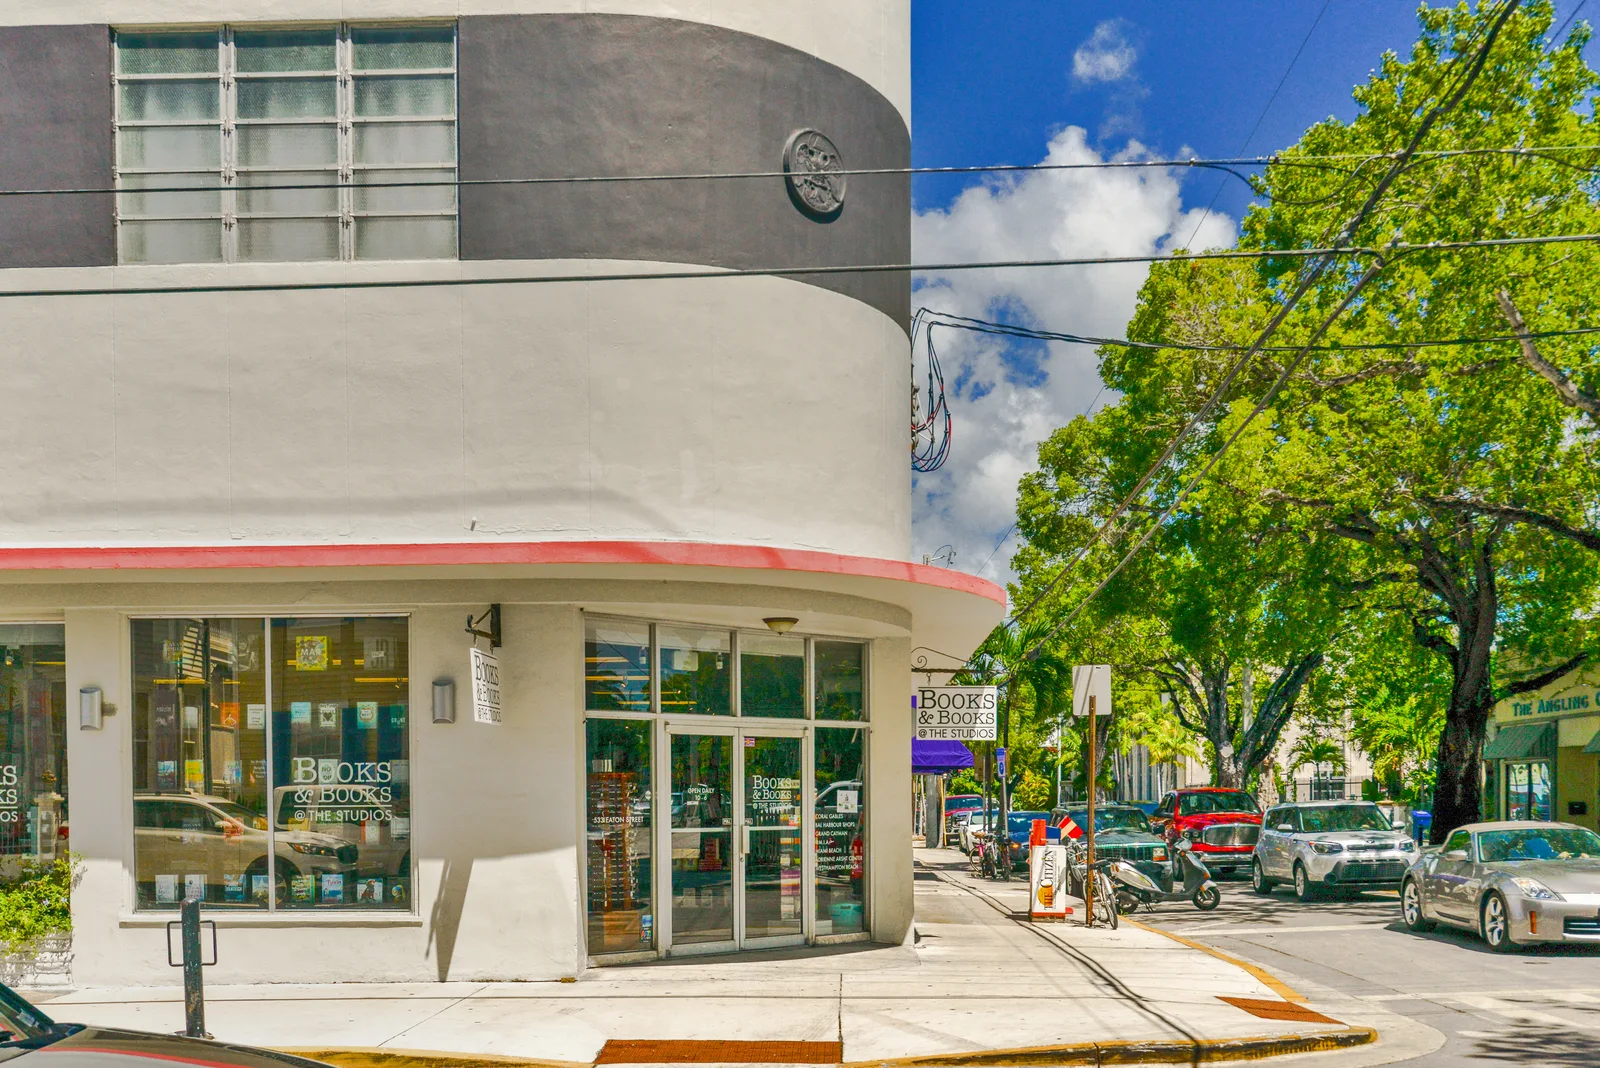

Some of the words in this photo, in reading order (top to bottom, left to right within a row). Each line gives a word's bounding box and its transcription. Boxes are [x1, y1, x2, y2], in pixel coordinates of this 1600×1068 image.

[474, 655, 499, 686] BOOKS
[483, 684, 500, 705] BOOKS
[918, 689, 995, 710] BOOKS
[1512, 702, 1533, 717] THE
[1537, 695, 1590, 714] ANGLING
[918, 710, 934, 725] &
[937, 710, 995, 725] BOOKS
[918, 728, 928, 739] @
[929, 728, 947, 738] THE
[951, 728, 994, 739] STUDIOS
[293, 757, 392, 783] BOOKS
[752, 774, 792, 789] BOOKS
[294, 785, 314, 803] &
[318, 784, 392, 803] BOOKS
[752, 789, 761, 800] &
[762, 789, 792, 800] BOOKS
[294, 809, 306, 822] @
[308, 810, 332, 821] THE
[336, 809, 393, 821] STUDIOS
[625, 815, 645, 823] STREET
[1040, 850, 1053, 888] CITIZEN
[1044, 891, 1053, 910] THE
